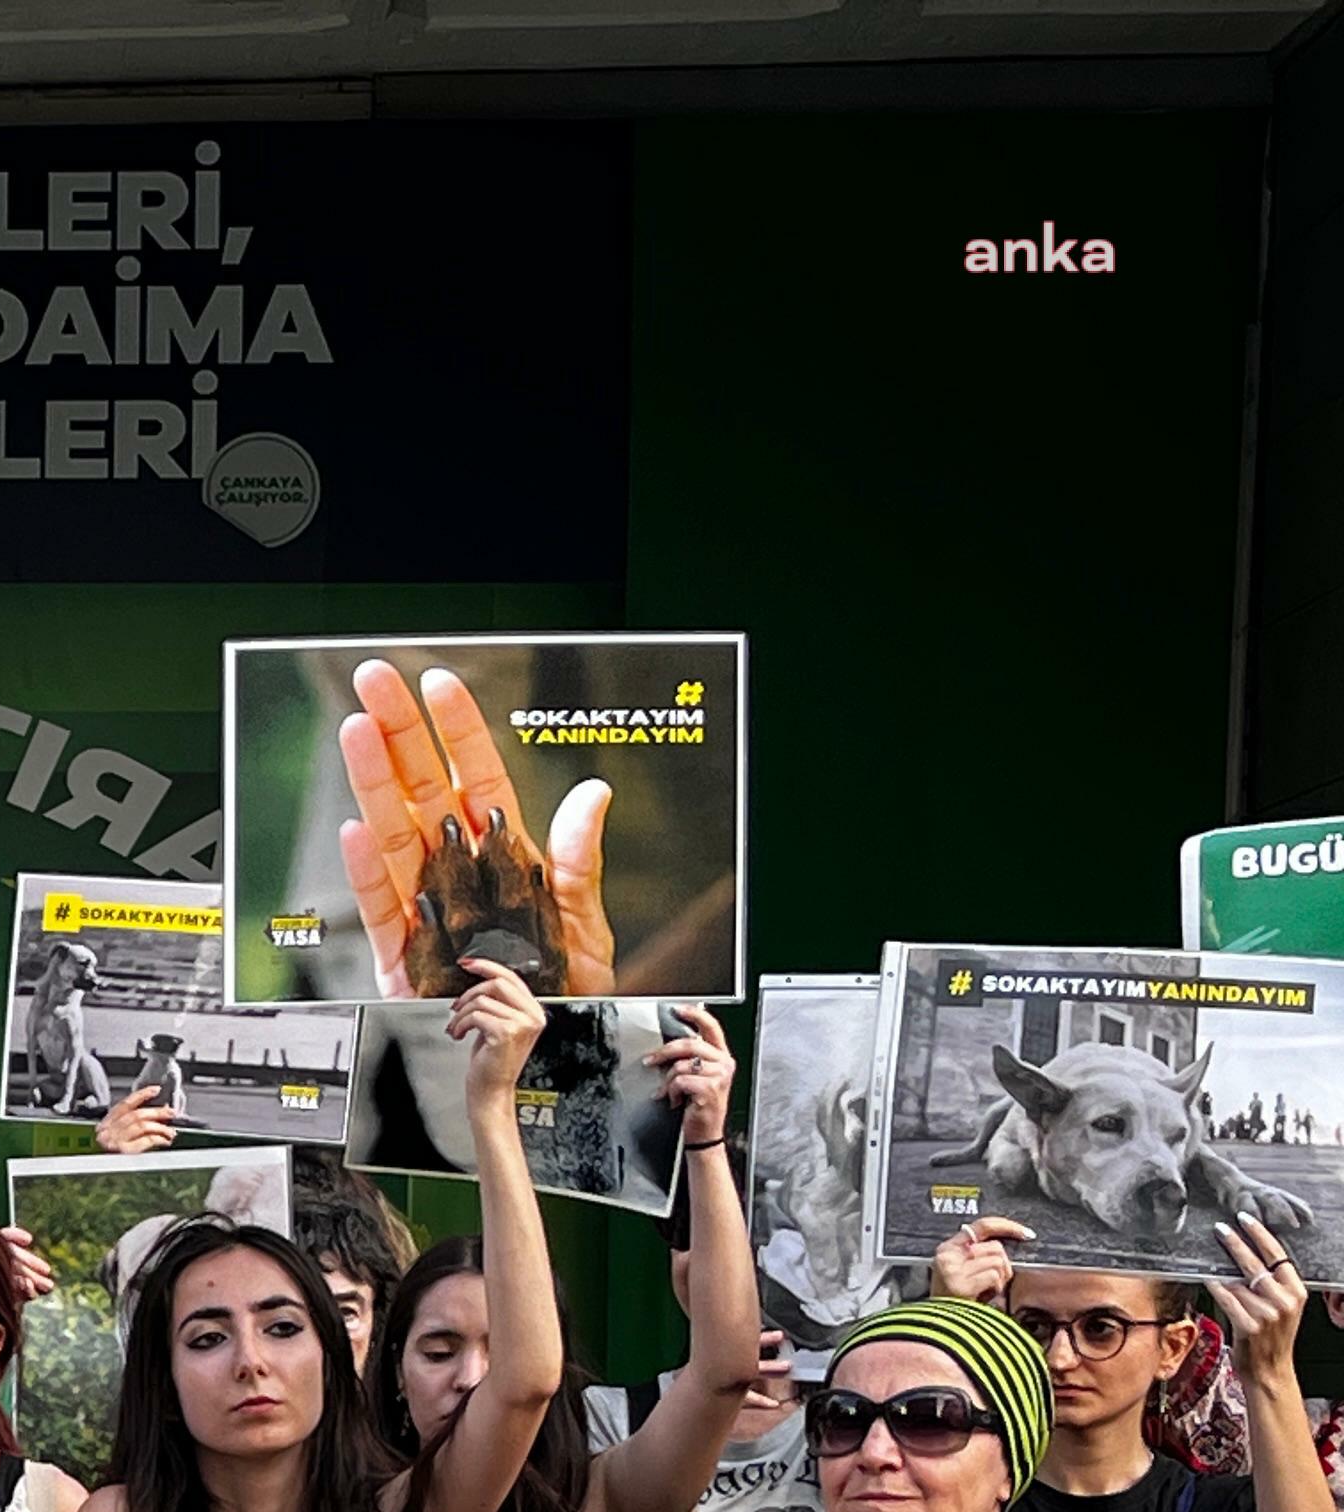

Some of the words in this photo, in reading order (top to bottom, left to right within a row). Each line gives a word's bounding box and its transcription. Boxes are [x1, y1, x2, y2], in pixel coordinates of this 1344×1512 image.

[220, 475, 304, 491] ÇANKAYA
[675, 681, 705, 706] #
[509, 709, 705, 727] SOKAKTAYIM
[515, 727, 705, 745] YANINDAYIM
[271, 929, 322, 947] YASA
[947, 969, 974, 996] #
[981, 974, 1307, 1008] SOKAKTAYIMYANINDAYIM
[931, 1197, 978, 1215] YASA
